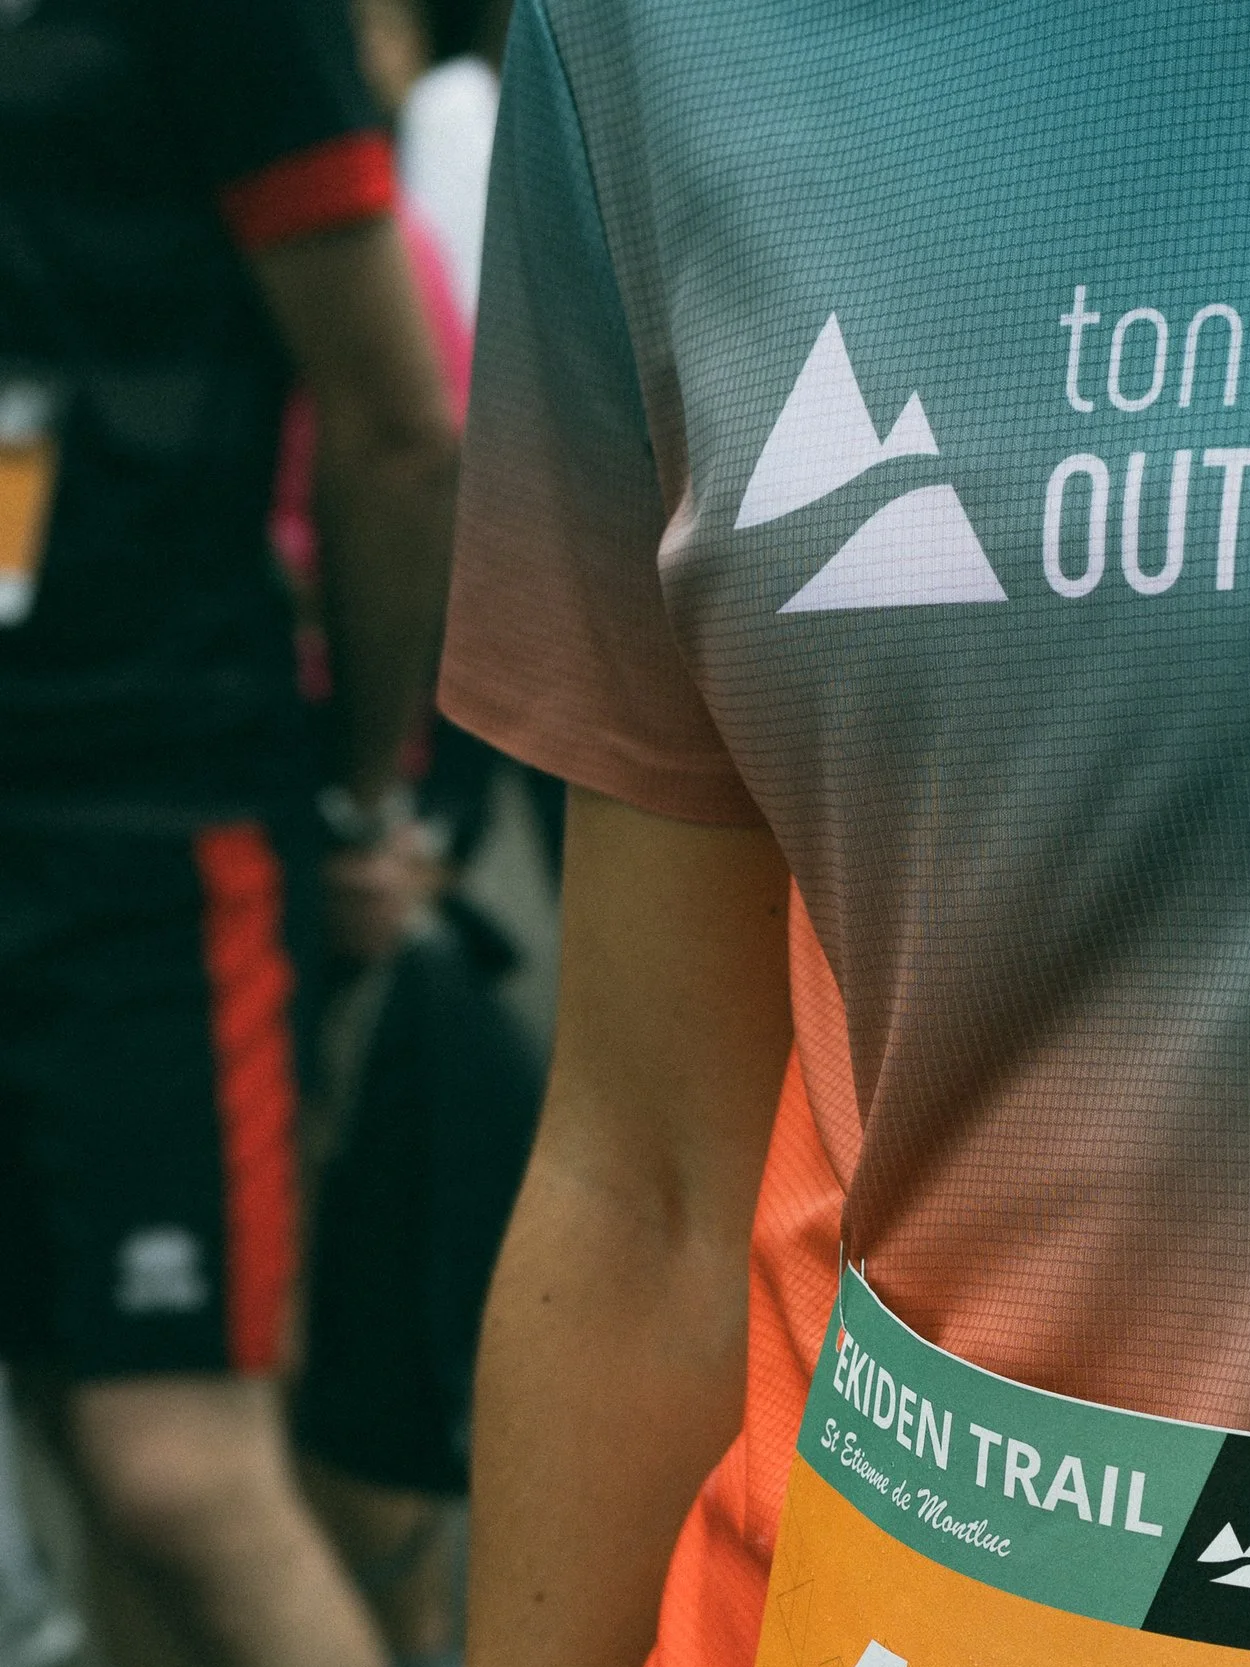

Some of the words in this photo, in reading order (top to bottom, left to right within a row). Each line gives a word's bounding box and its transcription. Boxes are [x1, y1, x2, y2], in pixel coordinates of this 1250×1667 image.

[820, 1418, 839, 1452] St
[841, 1432, 890, 1495] Etienne
[892, 1480, 911, 1511] de
[917, 1488, 1012, 1558] Montluc
[832, 1332, 953, 1471] EKIDEN
[968, 1422, 1164, 1538] TRAIL
